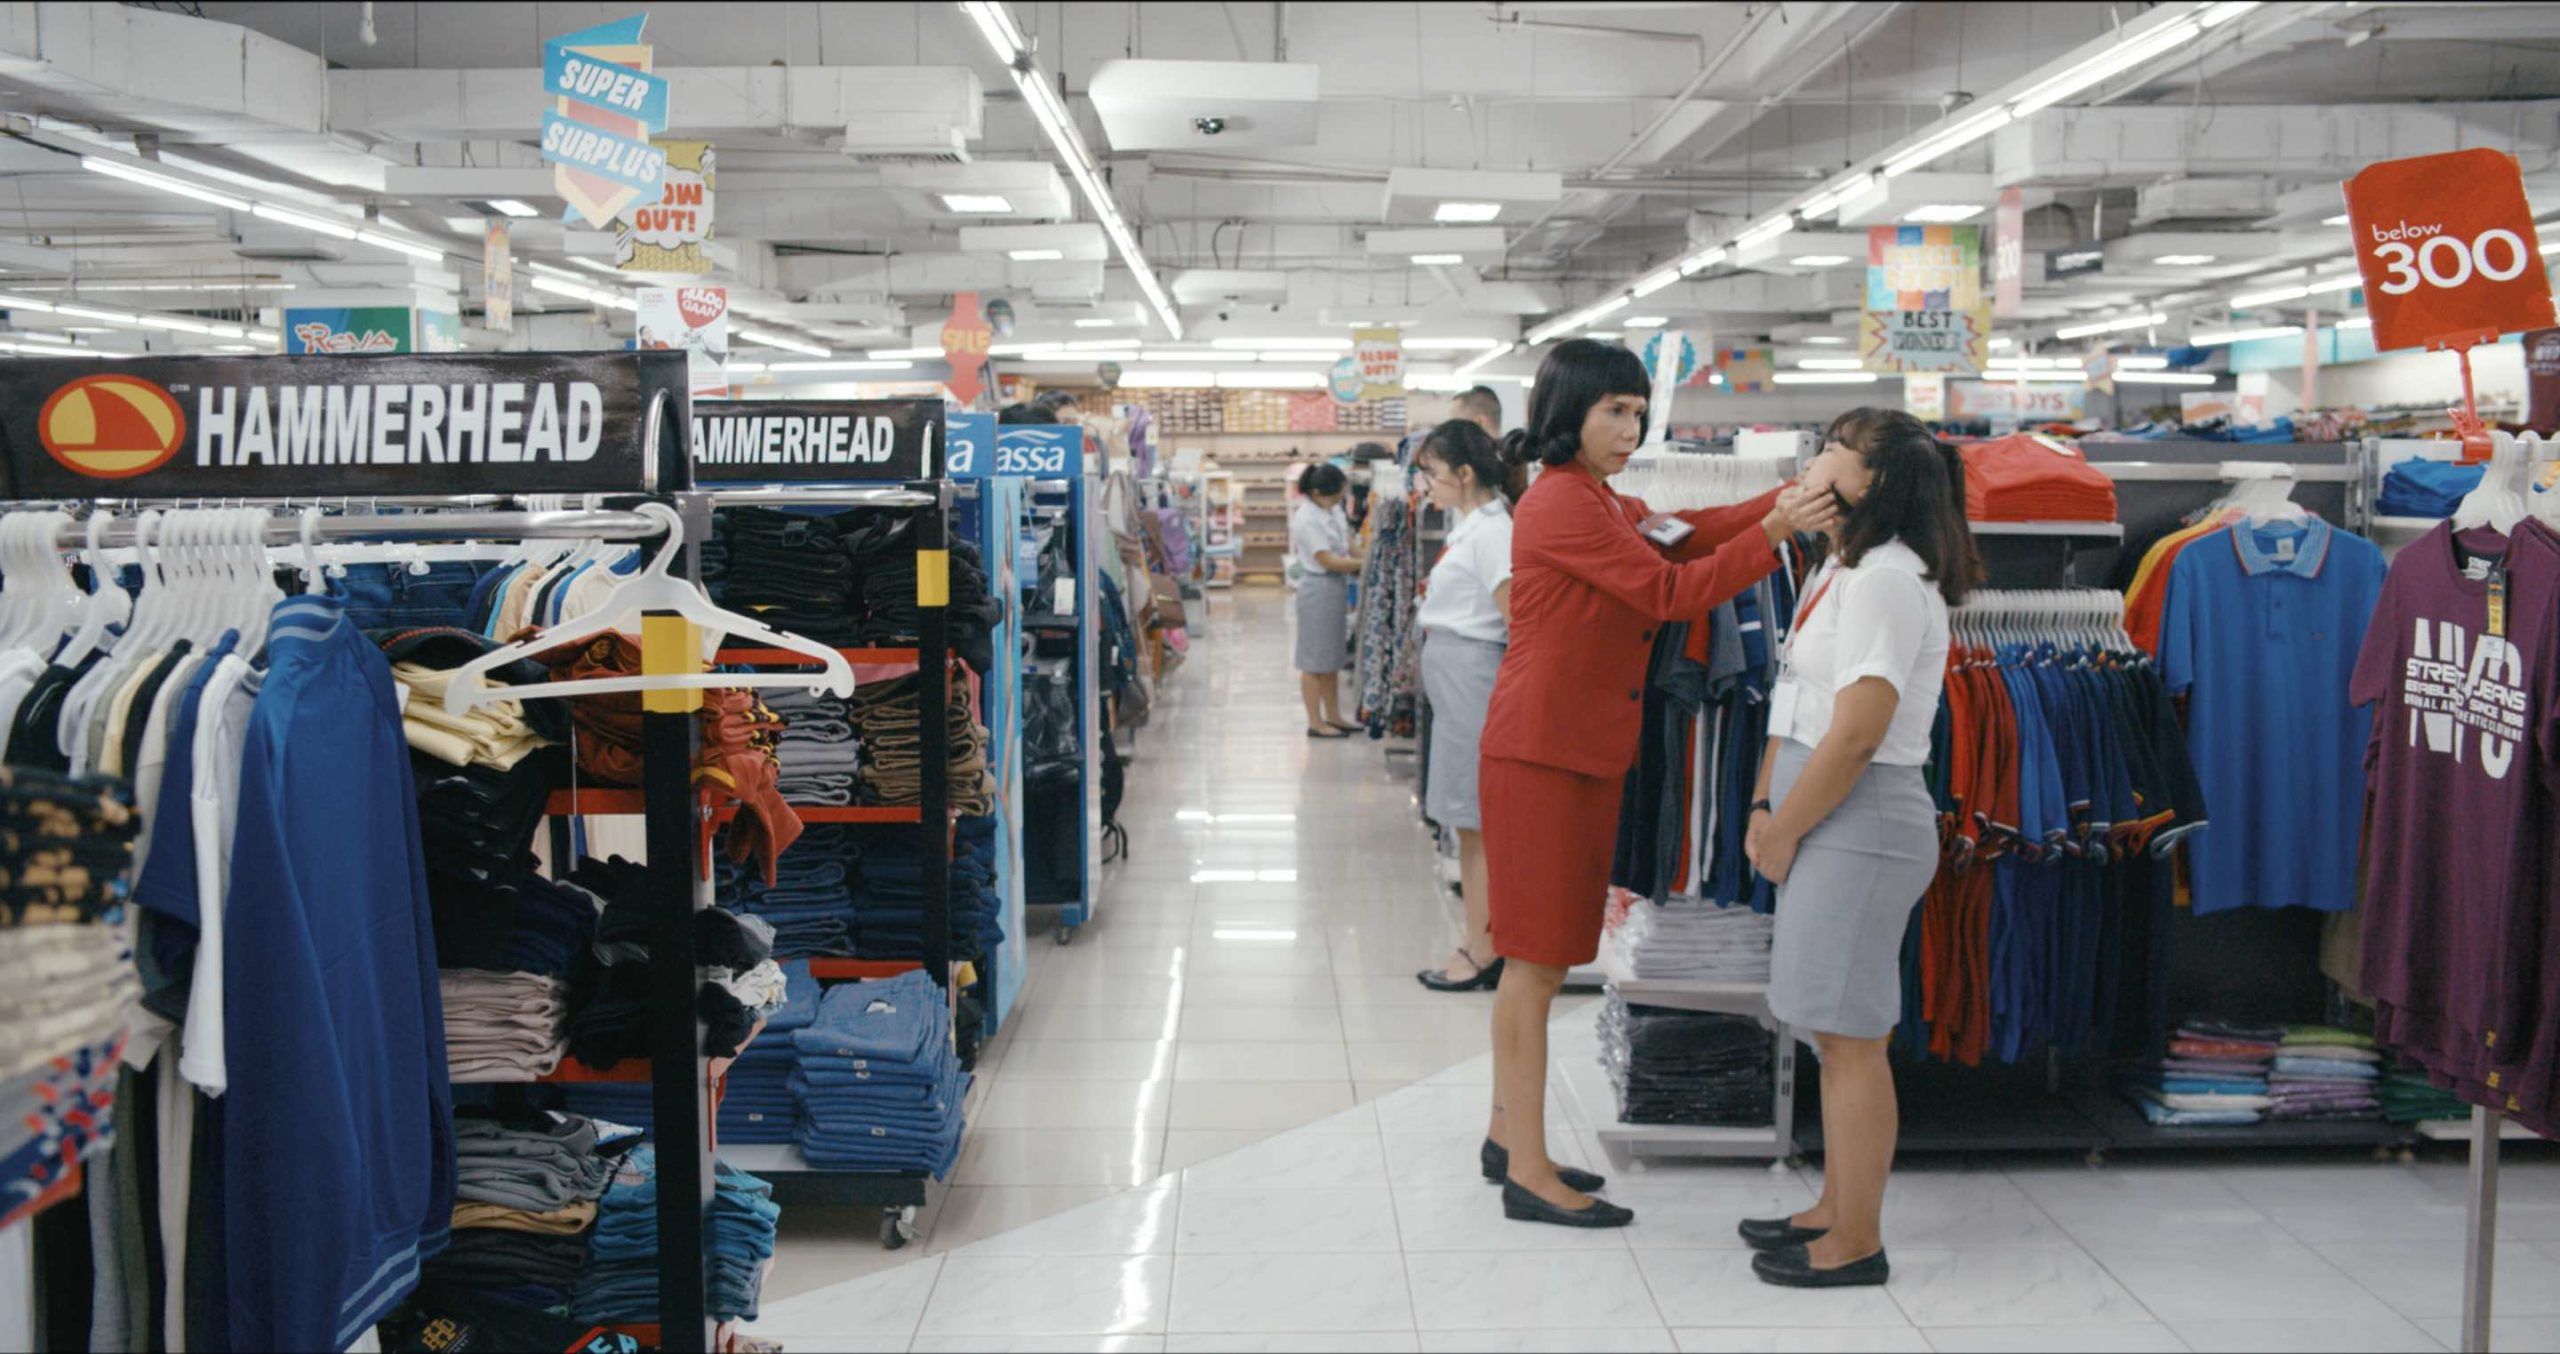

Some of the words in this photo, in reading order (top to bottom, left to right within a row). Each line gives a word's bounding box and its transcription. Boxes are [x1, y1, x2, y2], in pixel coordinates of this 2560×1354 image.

[559, 59, 650, 111] SUPER
[543, 121, 662, 183] SURPLUS
[661, 181, 703, 206] OW
[635, 208, 696, 232] OUT!
[2372, 220, 2443, 242] below
[2373, 228, 2528, 295] 300
[943, 328, 991, 354] SALE
[1903, 311, 1953, 328] BEST
[197, 381, 603, 467] HAMMERHEAD
[693, 416, 894, 464] AMMERHEAD
[2405, 657, 2467, 691] STRET
[2472, 679, 2527, 712] JEANS
